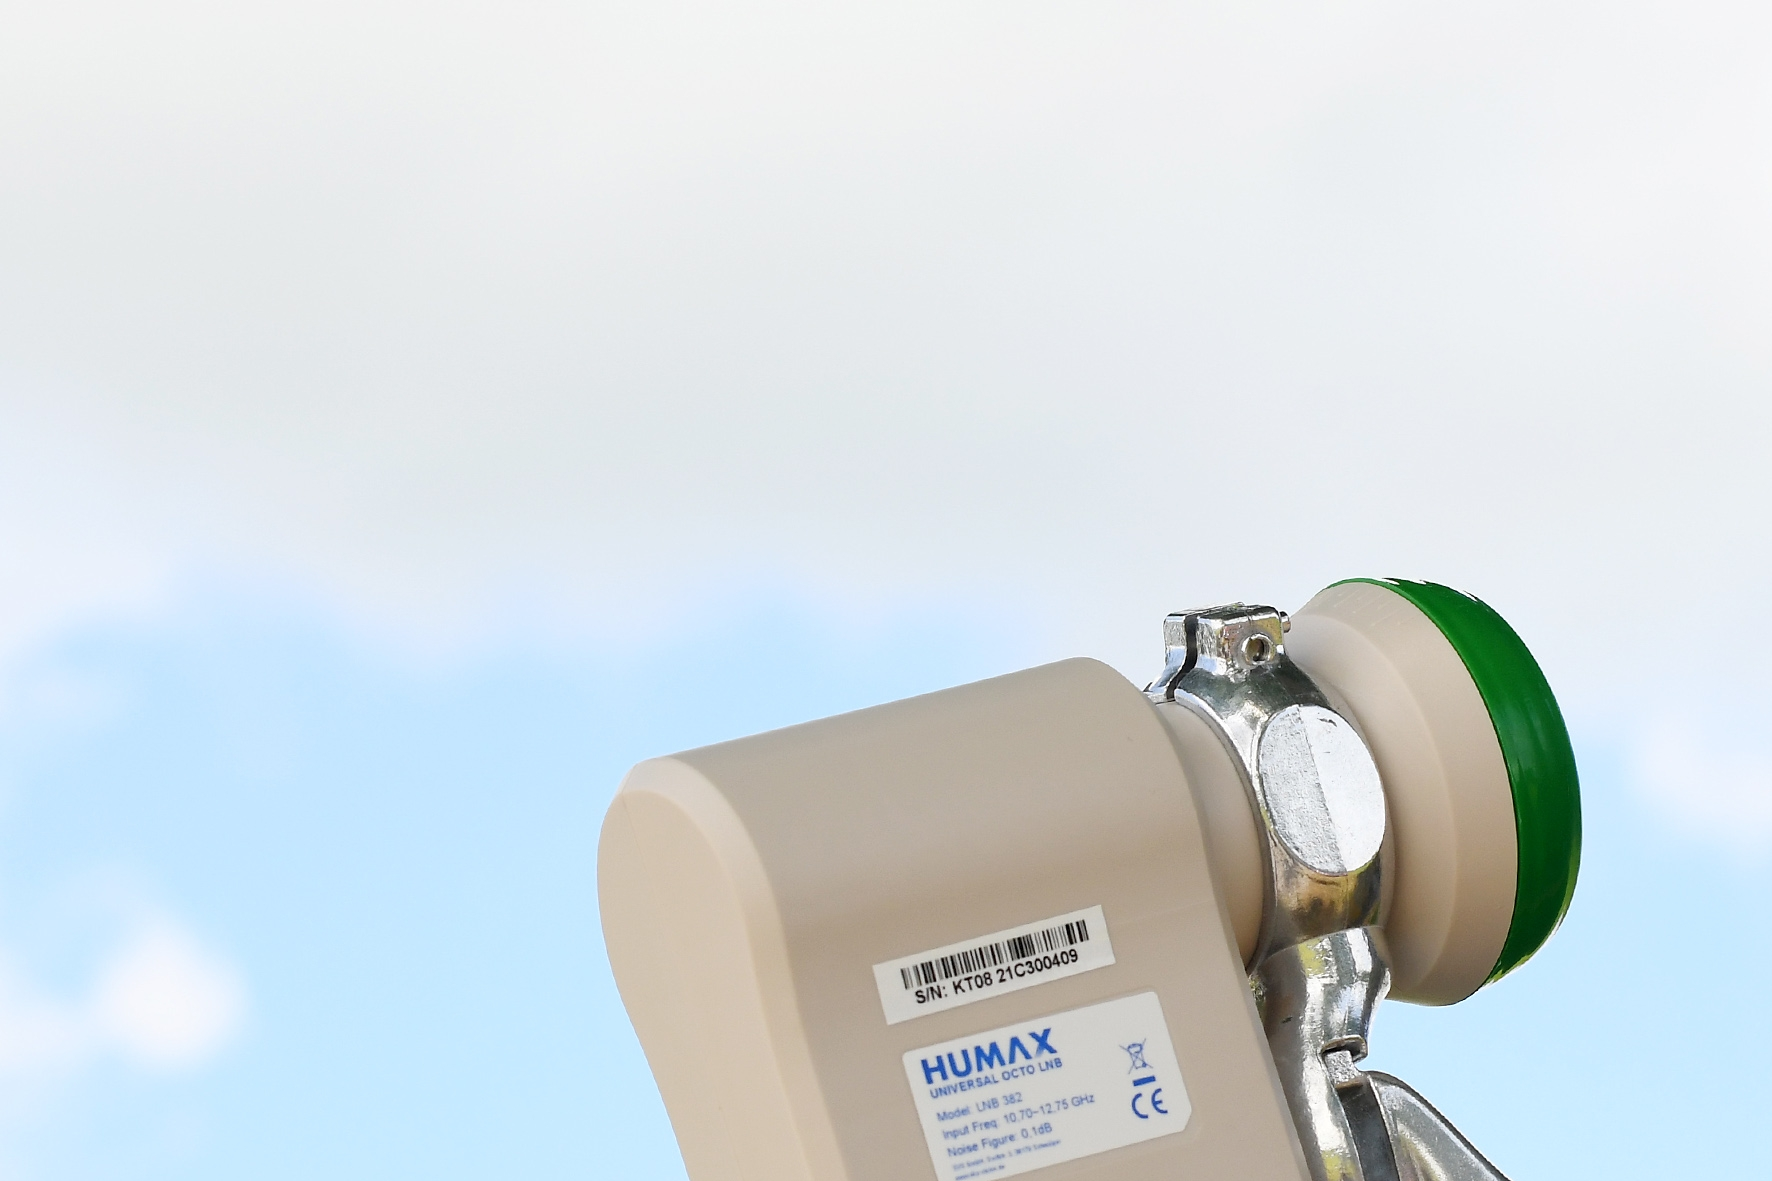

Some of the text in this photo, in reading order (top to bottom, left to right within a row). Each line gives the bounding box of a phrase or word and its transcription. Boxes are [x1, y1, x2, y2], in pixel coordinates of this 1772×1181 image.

[915, 949, 1079, 1004] S/N: KT08 21C300409
[921, 1028, 1057, 1085] HUMAX
[929, 1057, 1063, 1099] UNIVERSAL OCTO LNB
[942, 1125, 969, 1141] Input
[1070, 1093, 1095, 1108] GHz
[976, 1097, 1000, 1113] LNB
[1002, 1091, 1023, 1106] 382
[1131, 1088, 1168, 1119] CE
[947, 1142, 979, 1158] Noise
